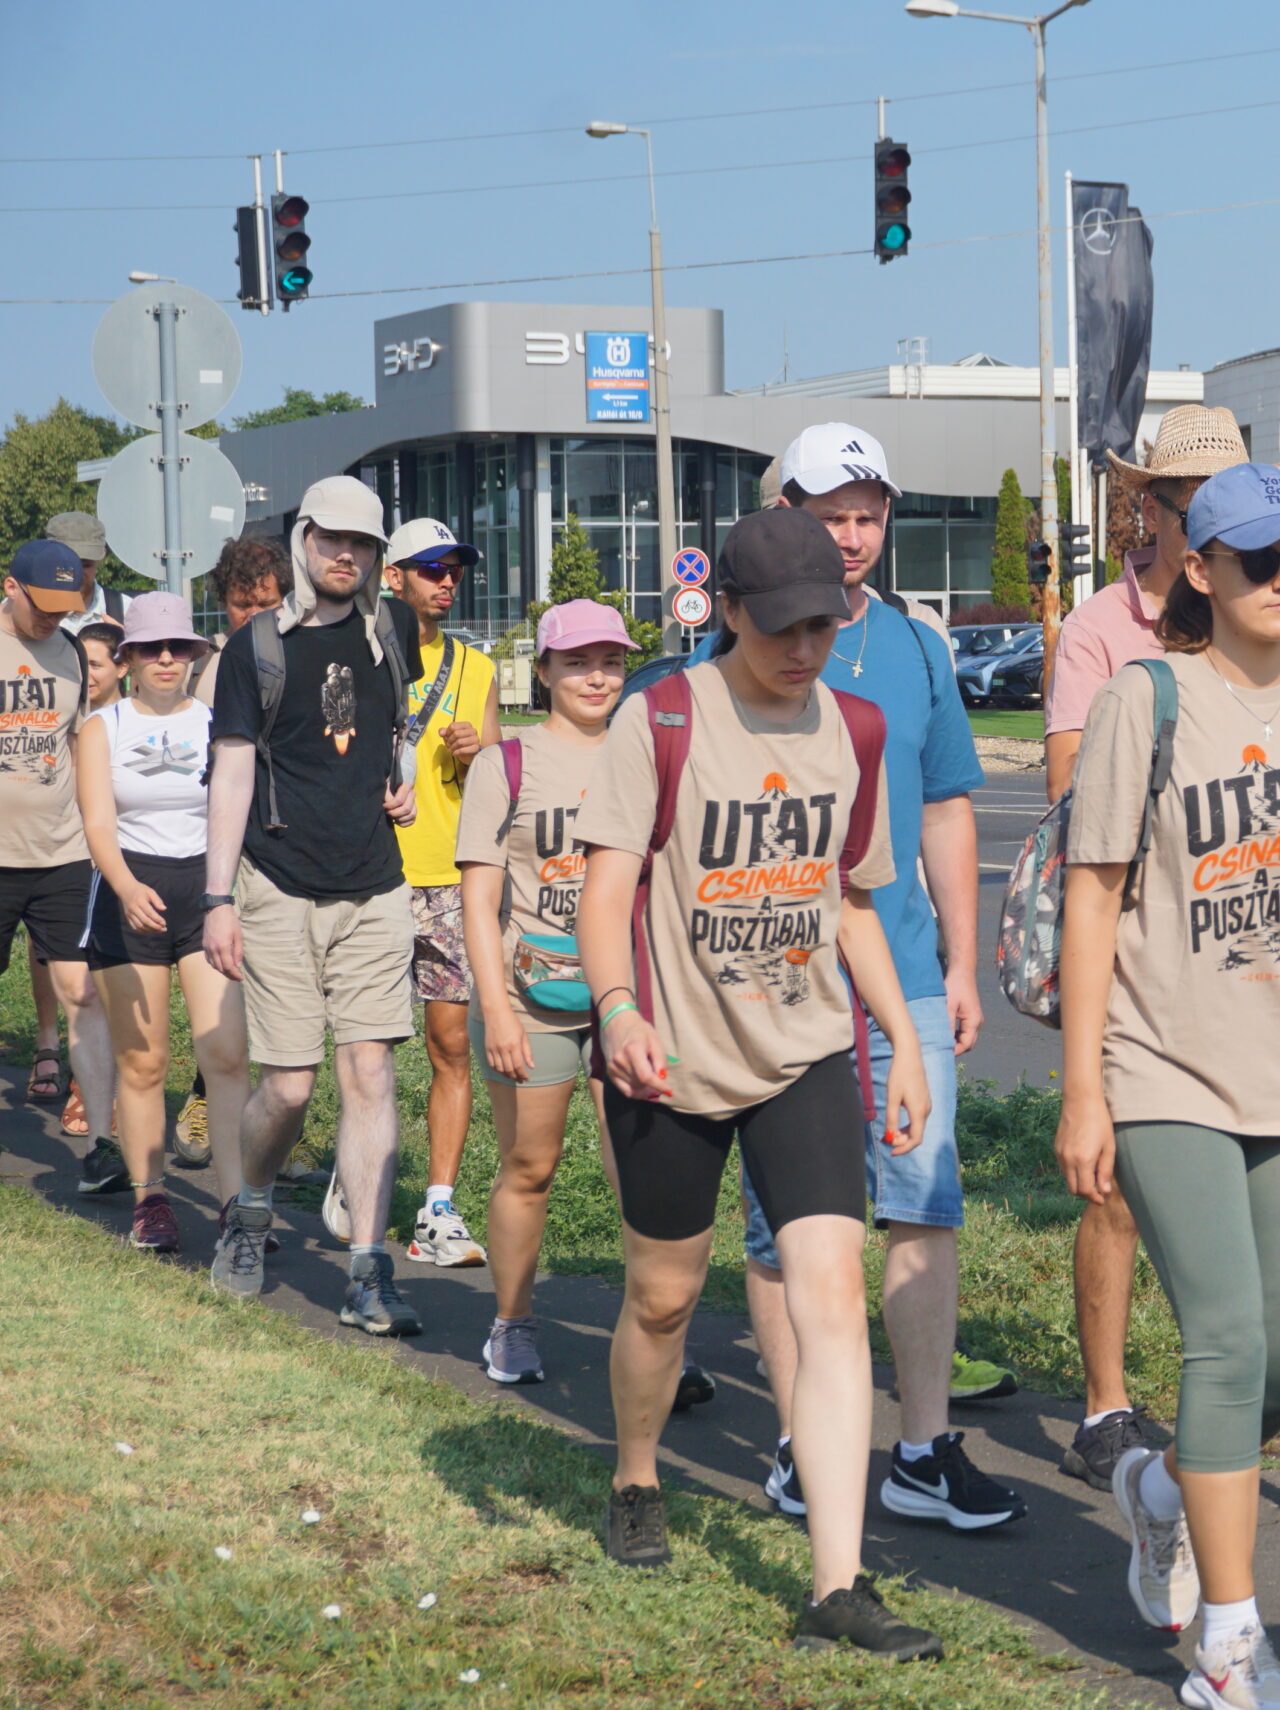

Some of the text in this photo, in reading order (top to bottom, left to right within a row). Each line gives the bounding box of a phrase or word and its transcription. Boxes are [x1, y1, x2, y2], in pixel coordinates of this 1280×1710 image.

[592, 367, 645, 379] Husqvarna
[0, 708, 60, 728] SINÁLOK
[20, 727, 28, 736] A
[0, 733, 57, 755] SZTÁBAN
[699, 792, 836, 870] UTAT
[697, 856, 835, 903] CSINÁLOK
[1254, 868, 1269, 888] A
[760, 896, 772, 914] A
